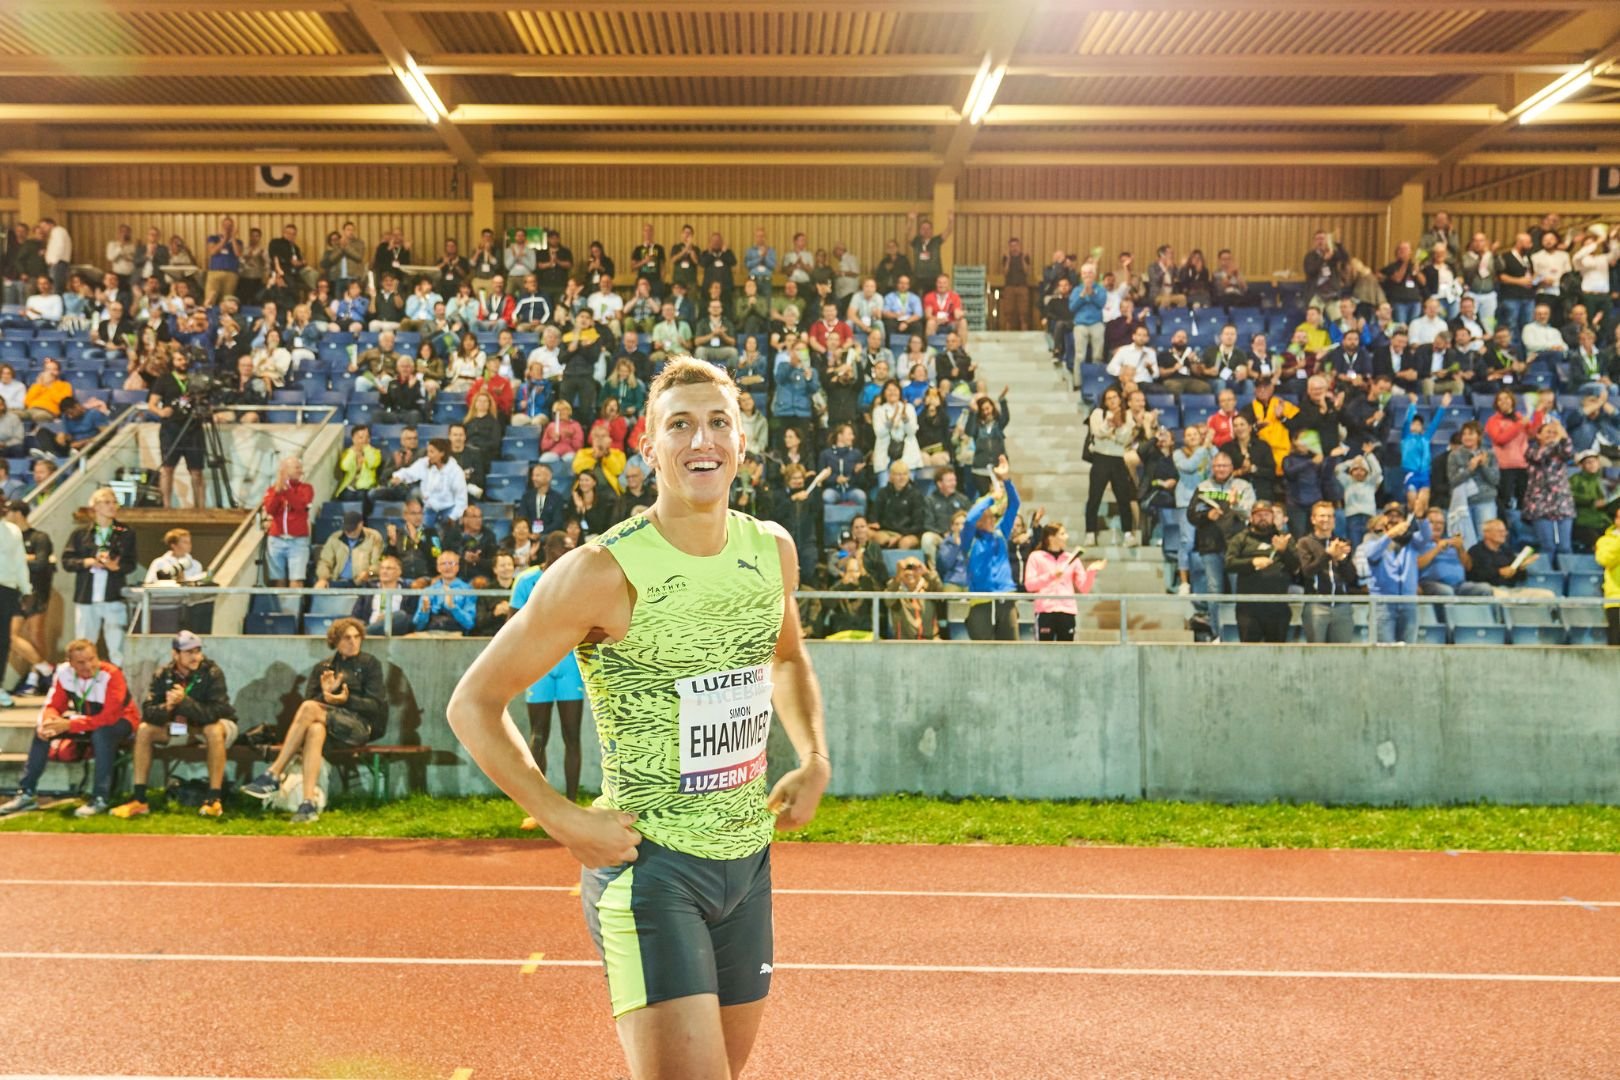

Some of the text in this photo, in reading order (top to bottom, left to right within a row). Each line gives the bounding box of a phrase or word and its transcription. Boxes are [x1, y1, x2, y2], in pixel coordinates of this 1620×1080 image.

[646, 581, 687, 594] MATHYS
[729, 705, 751, 719] SIMON
[690, 710, 769, 758] EHAMMER
[684, 766, 747, 793] LUZERN
